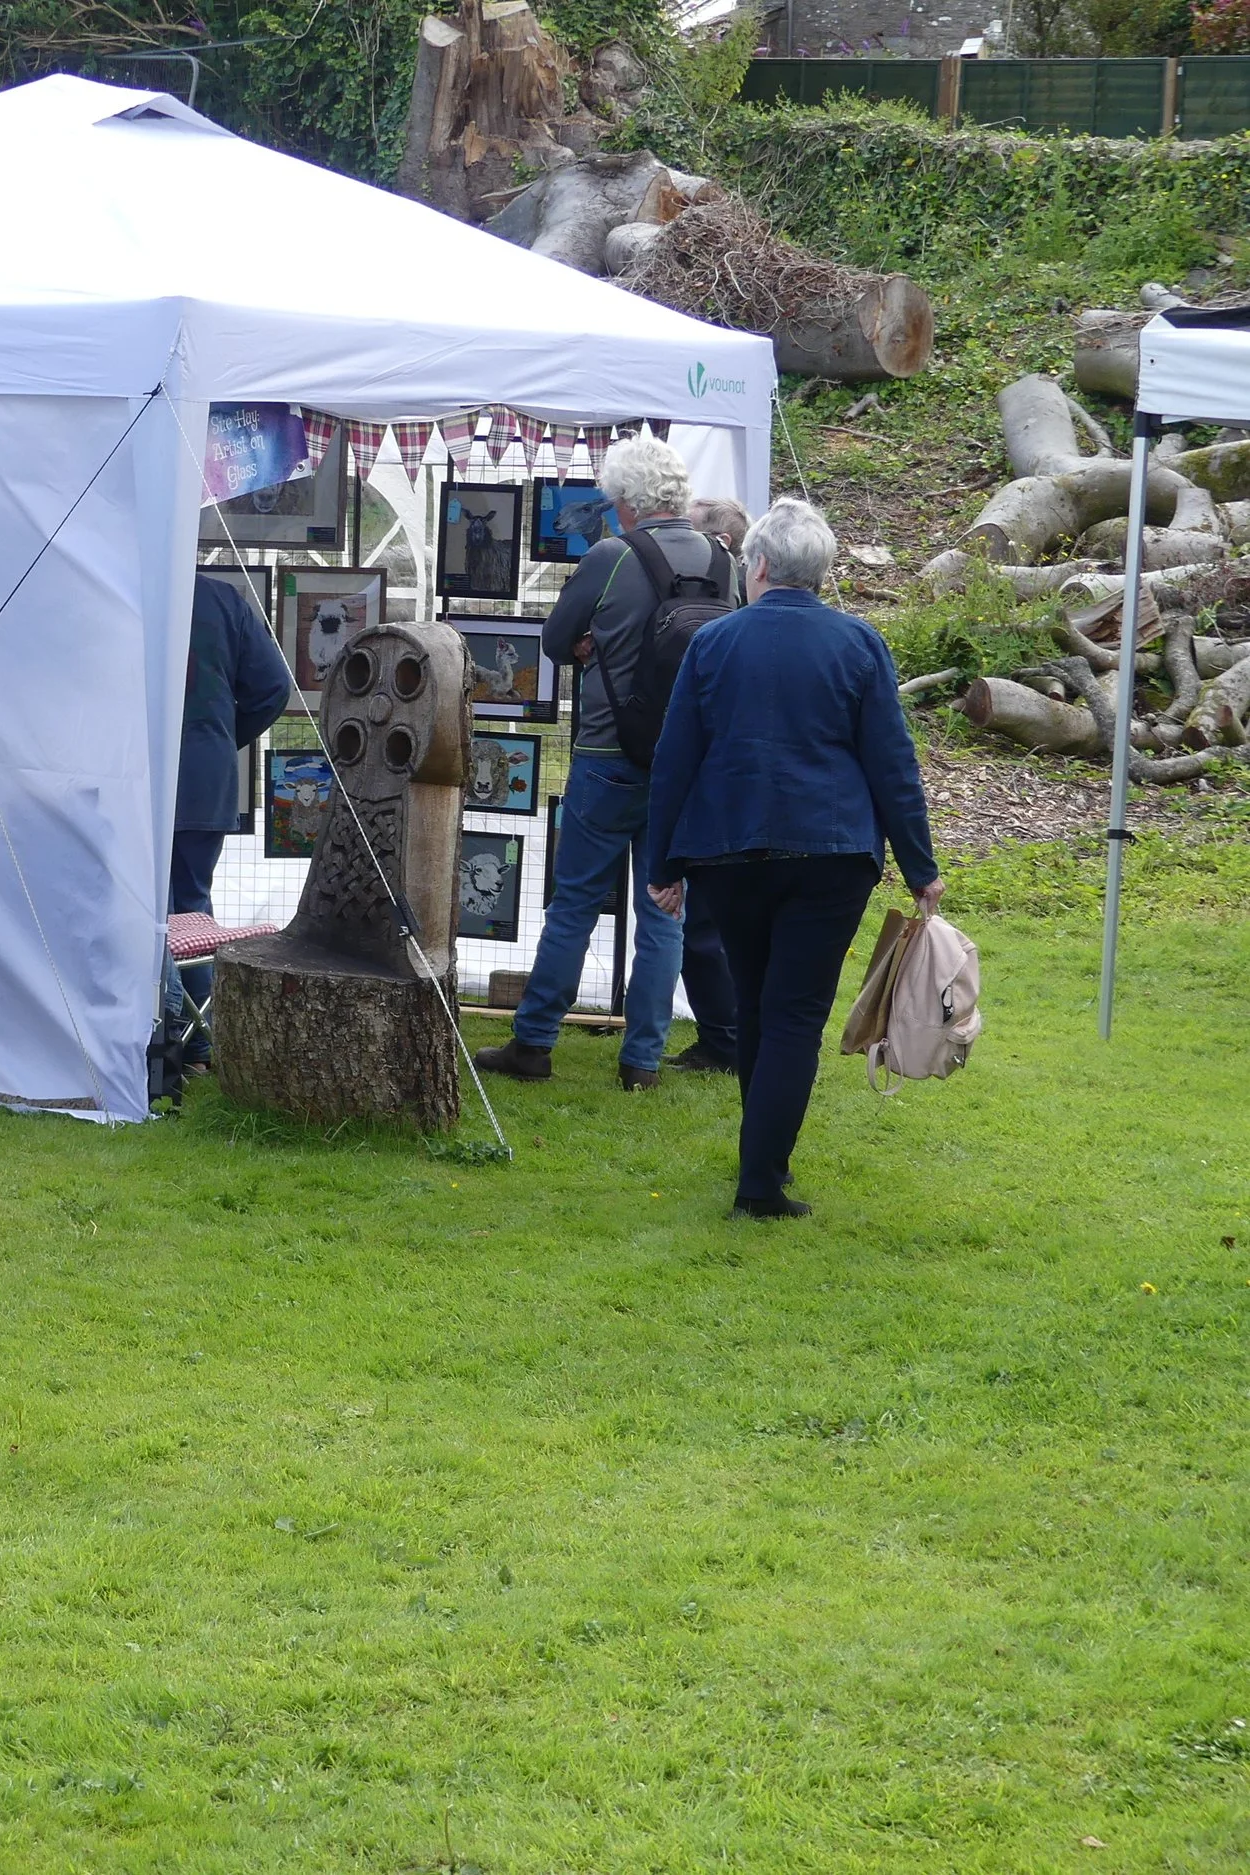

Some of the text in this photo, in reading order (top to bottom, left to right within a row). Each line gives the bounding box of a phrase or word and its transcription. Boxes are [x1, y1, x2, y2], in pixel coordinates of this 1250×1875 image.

[709, 377, 746, 395] vounot
[210, 416, 232, 435] Sue
[213, 434, 266, 461] Artist on
[227, 463, 258, 490] Glass
